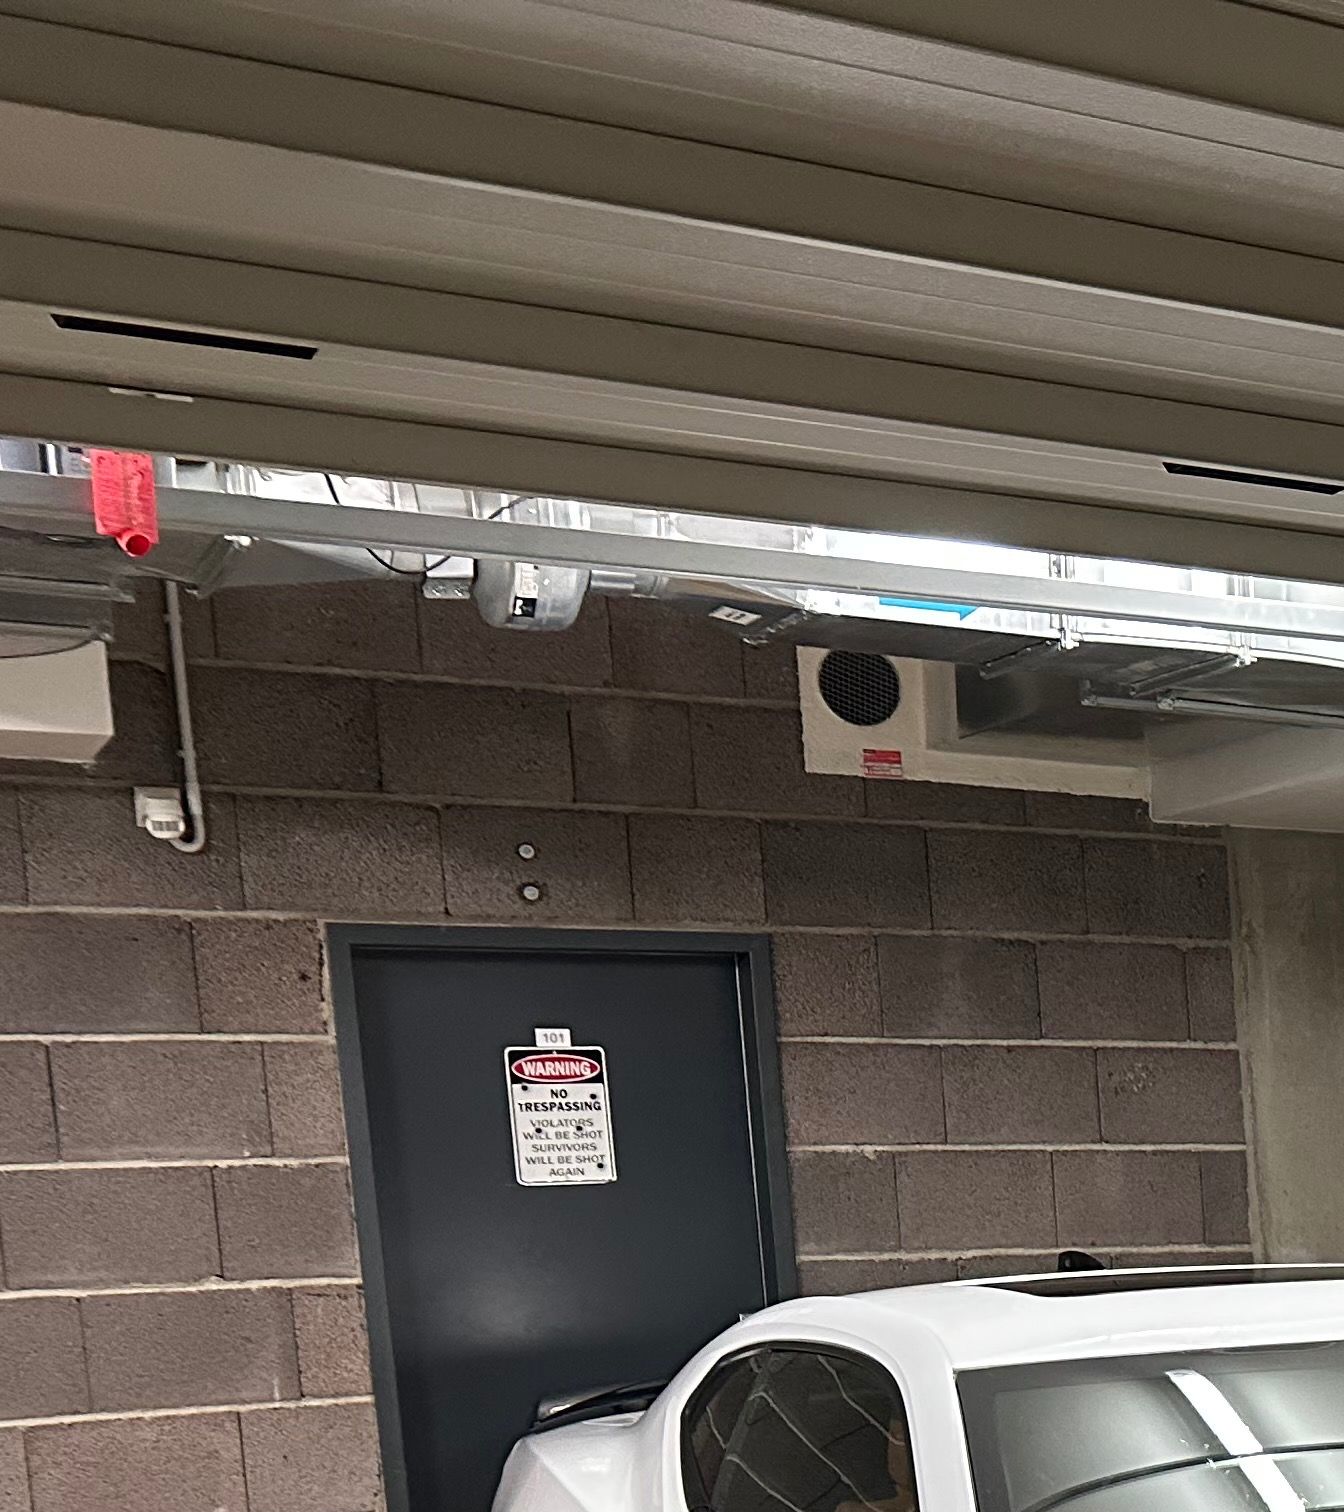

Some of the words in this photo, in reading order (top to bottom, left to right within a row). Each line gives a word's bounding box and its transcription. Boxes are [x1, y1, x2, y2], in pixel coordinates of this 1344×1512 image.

[543, 1033, 565, 1044] 101
[521, 1060, 592, 1077] WARNING
[550, 1088, 568, 1099] NO
[518, 1101, 602, 1112] TRESPASSING
[529, 1118, 594, 1128] VIOLATORS
[522, 1131, 551, 1141] WILL
[555, 1131, 571, 1140] BE
[572, 1130, 603, 1140] SHOT
[531, 1143, 598, 1153] SURVIVORS
[525, 1156, 555, 1165] WILL
[557, 1155, 574, 1165] BE
[575, 1154, 606, 1164] SHOT
[549, 1167, 585, 1177] AGAIN
